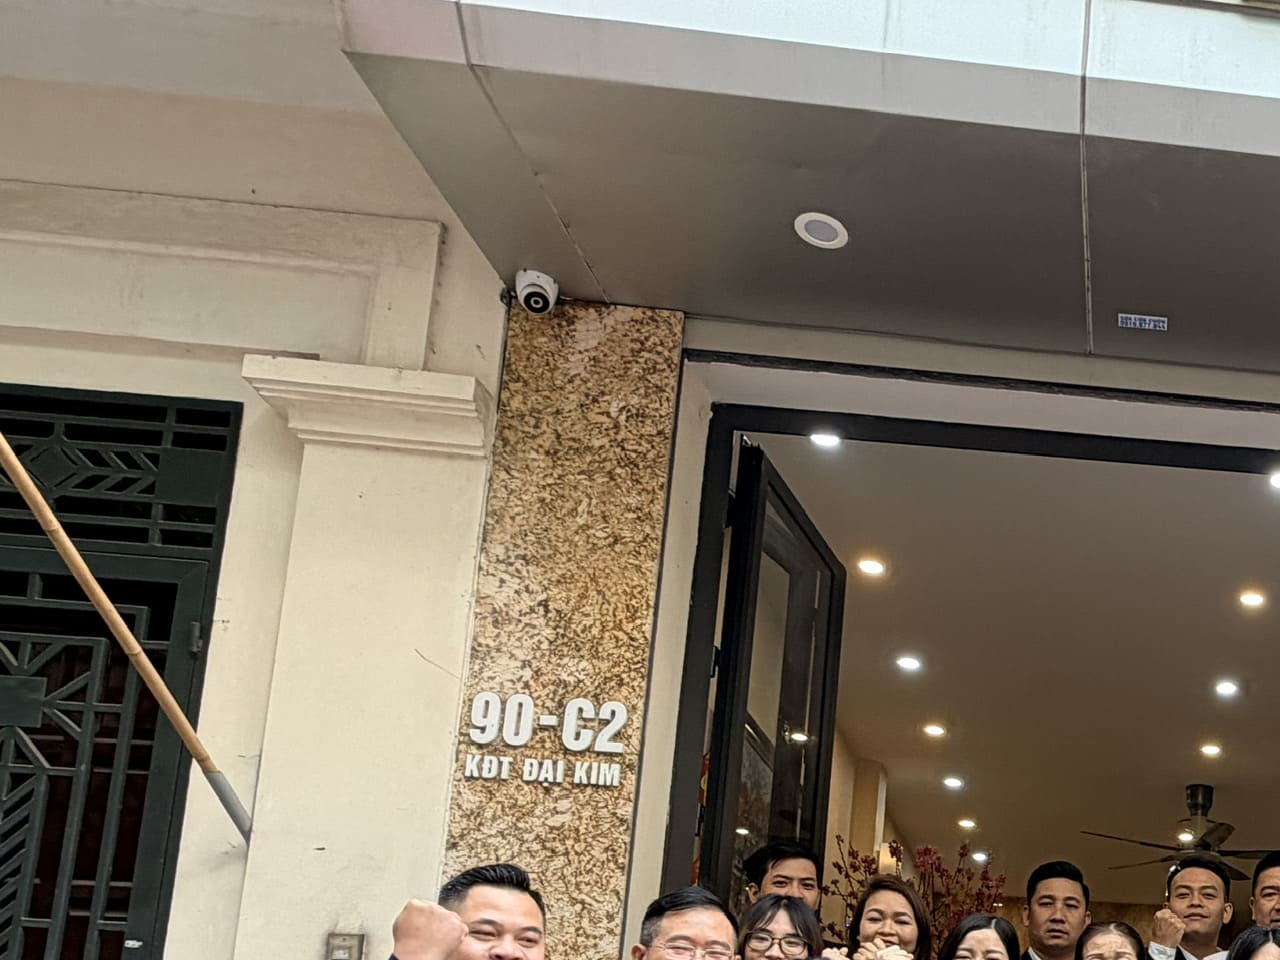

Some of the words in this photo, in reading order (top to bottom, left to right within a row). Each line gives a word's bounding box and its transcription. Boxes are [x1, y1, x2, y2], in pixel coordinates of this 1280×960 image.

[469, 691, 628, 753] 90-C2
[464, 754, 513, 779] KĐT
[522, 758, 565, 787] ĐẠI
[574, 761, 621, 787] KIM
